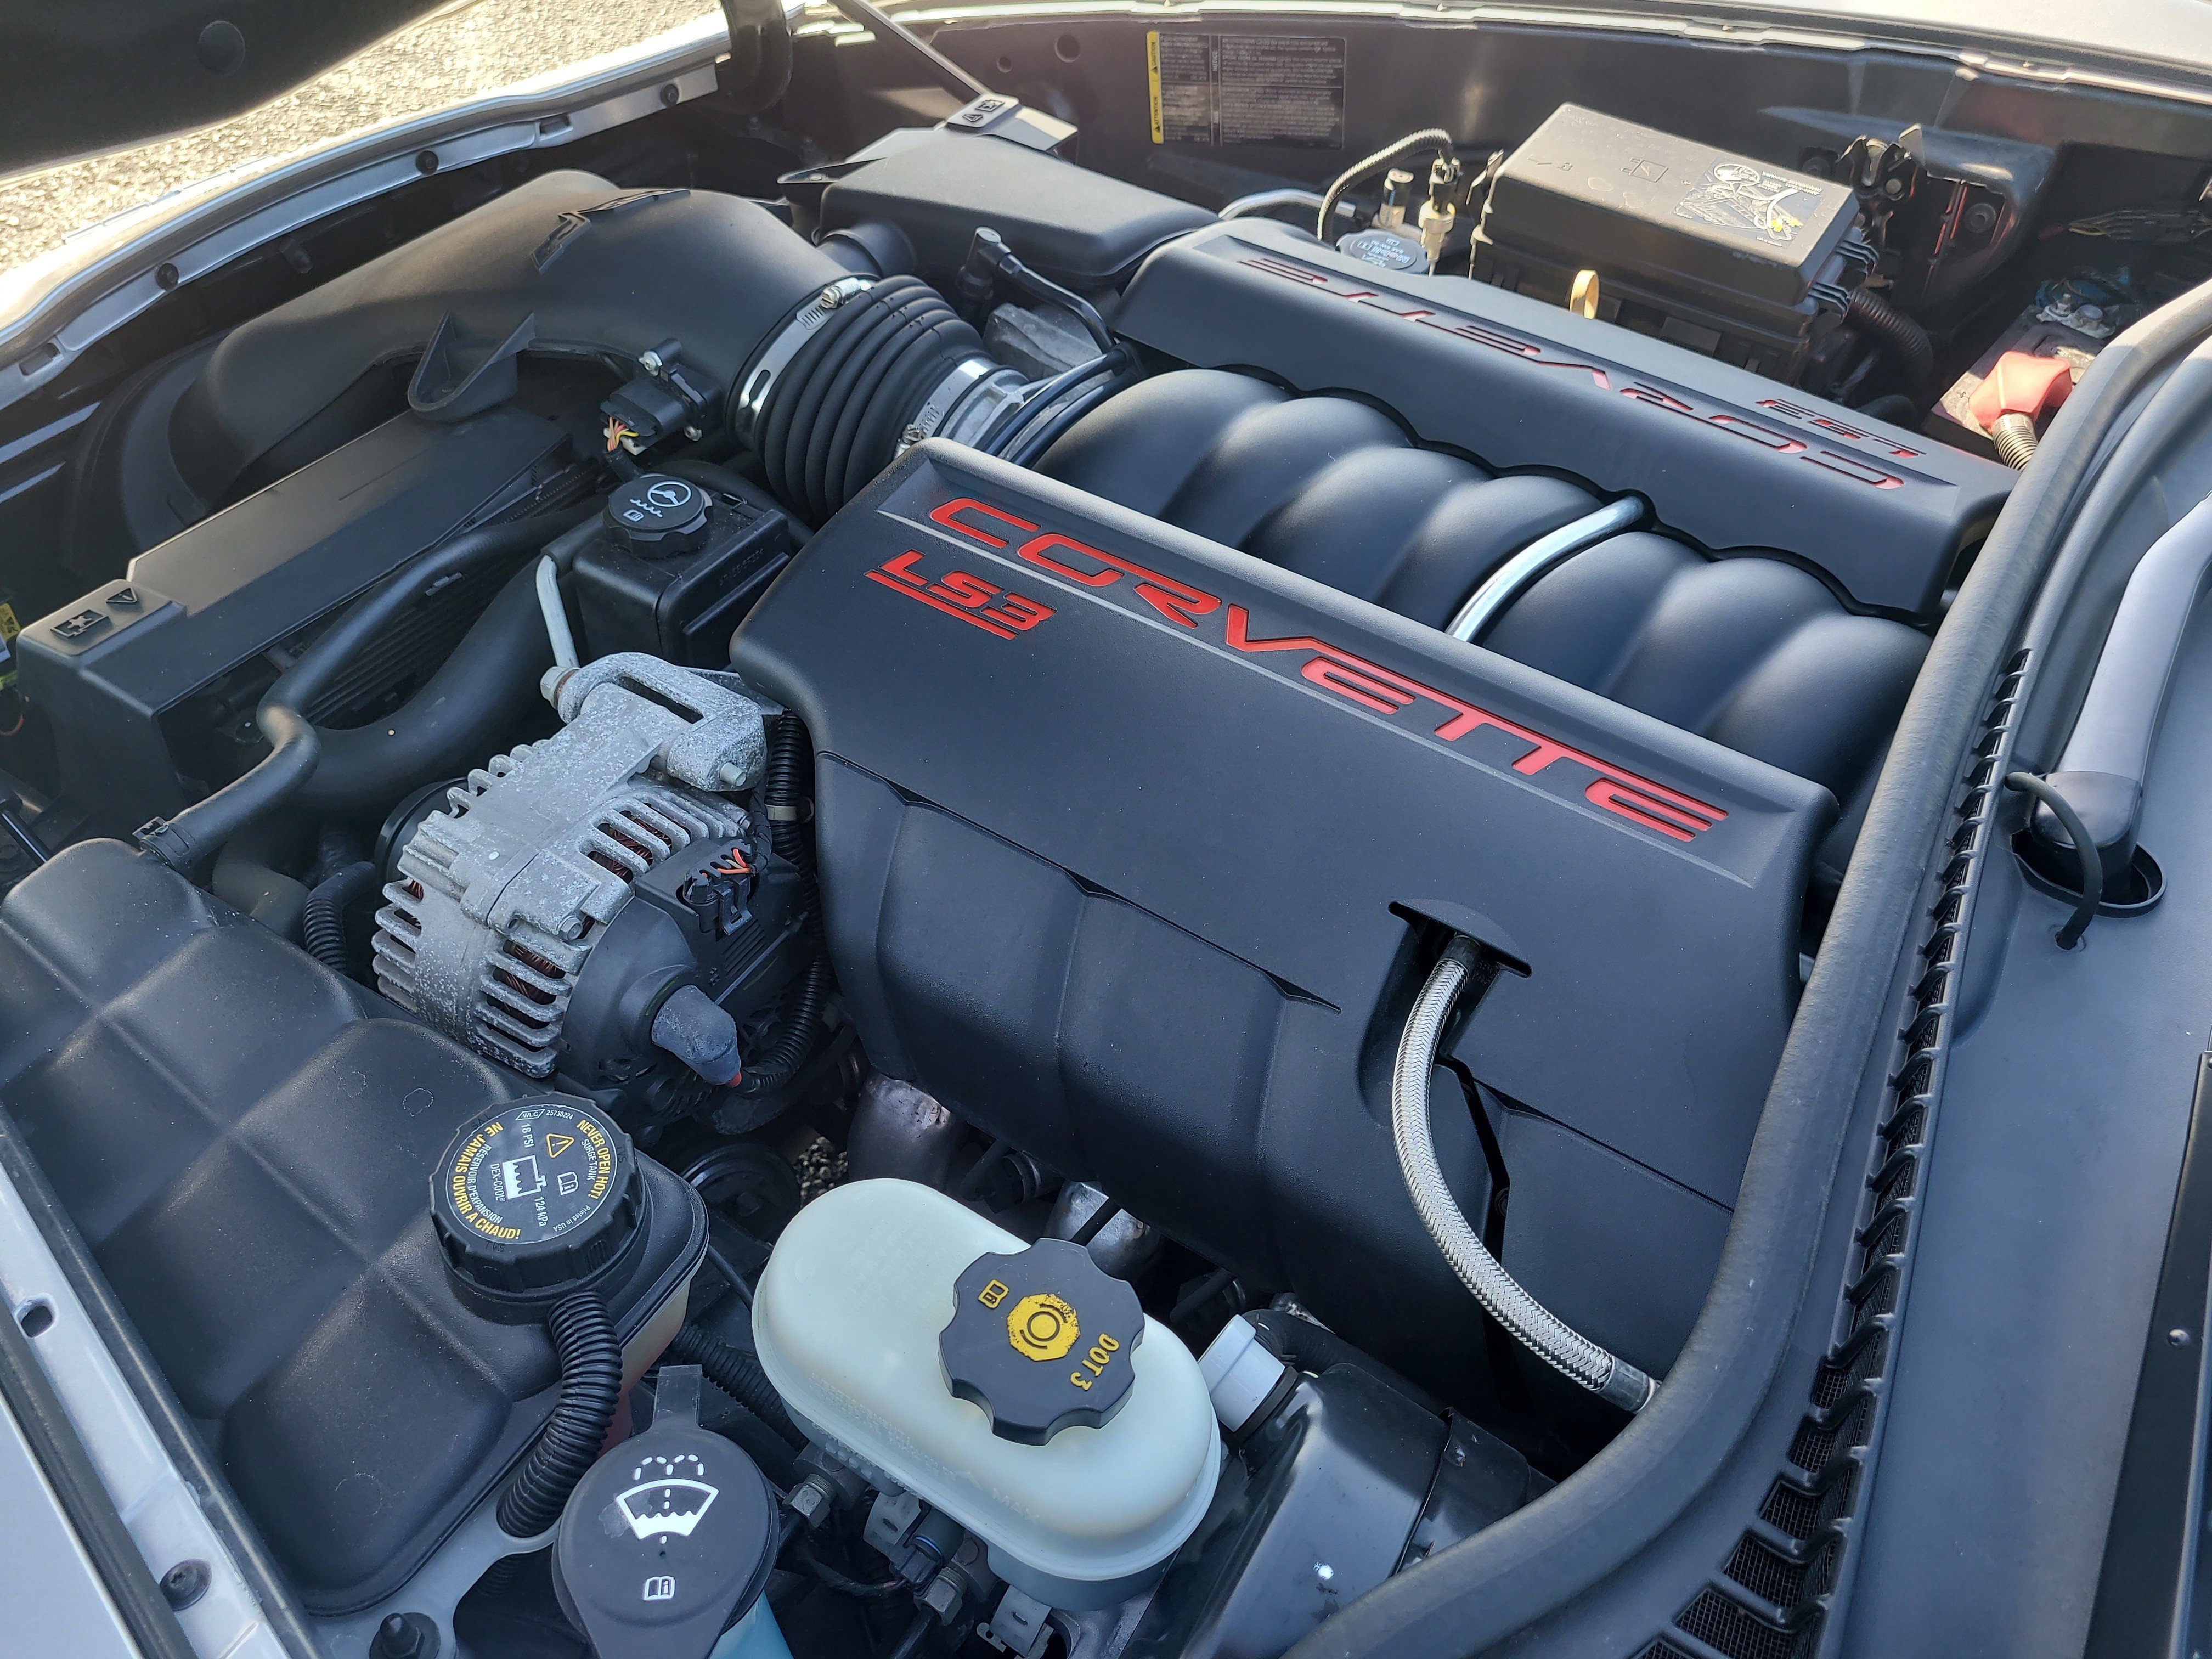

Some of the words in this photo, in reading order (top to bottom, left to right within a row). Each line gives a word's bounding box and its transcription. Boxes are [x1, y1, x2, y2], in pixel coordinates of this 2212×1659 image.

[1237, 258, 1904, 490] CORVETTE
[1756, 399, 1920, 459] LS3
[872, 549, 1057, 635] LS3
[929, 496, 1728, 842] CORVETTE
[546, 1110, 574, 1120] 25730224
[484, 1121, 504, 1137] NE
[521, 1122, 532, 1133] 18
[576, 1119, 605, 1148] NEVER
[454, 1133, 486, 1173] JAMAIS
[523, 1135, 534, 1148] PSI
[580, 1138, 597, 1162] SURGE
[586, 1162, 597, 1181] TANK
[597, 1147, 611, 1173] OPEN
[452, 1175, 473, 1215] OUVRIR
[588, 1176, 609, 1200] HOT!
[467, 1183, 503, 1224] D'EXPANSION
[534, 1196, 545, 1211] 124
[573, 1205, 591, 1222] Printed
[465, 1212, 478, 1223] A
[475, 1217, 521, 1240] CHAUD!
[553, 1222, 567, 1232] USA
[1082, 1333, 1120, 1376] DOT
[1070, 1372, 1092, 1391] 3
